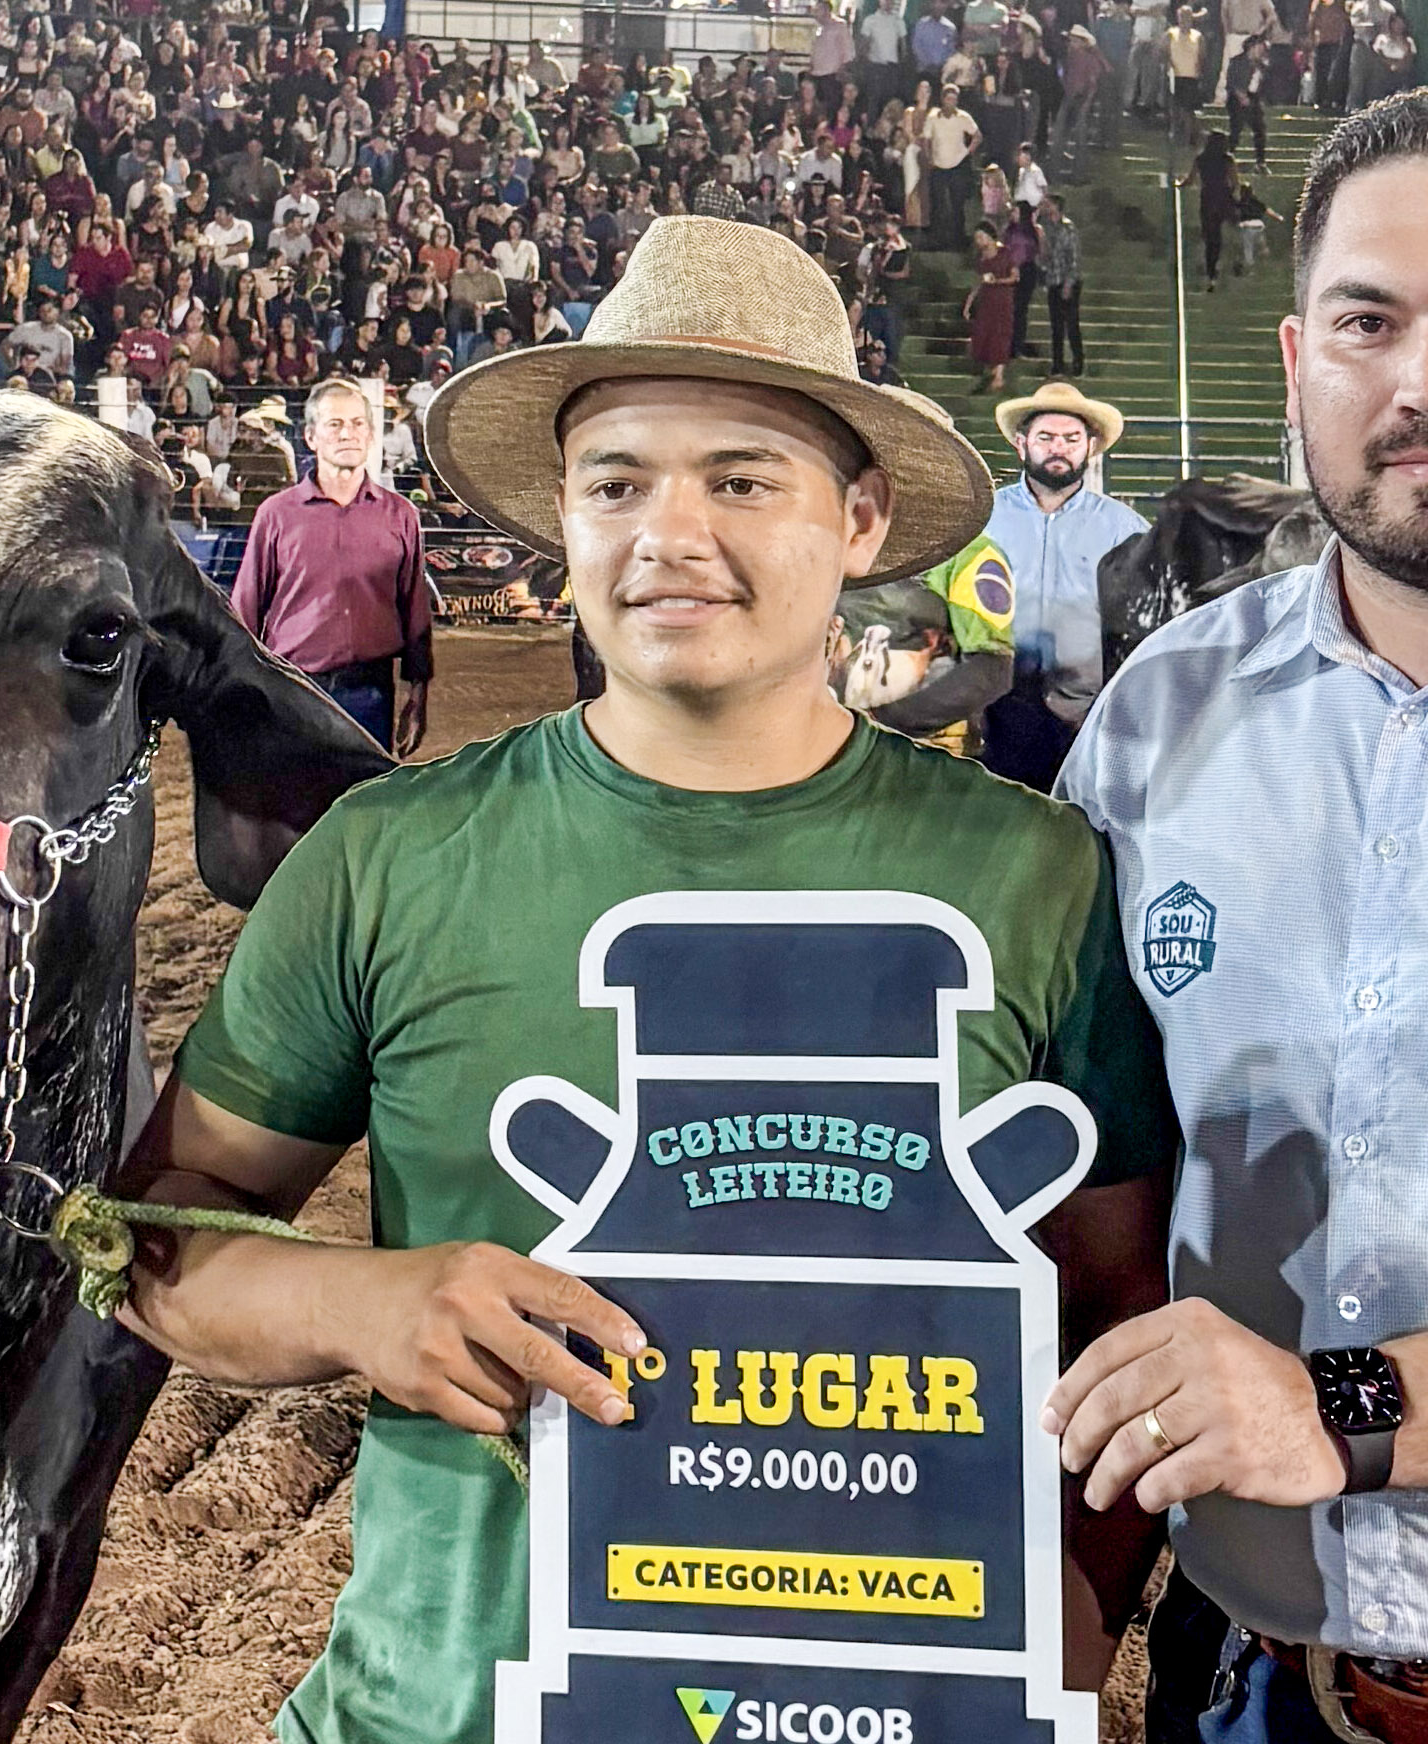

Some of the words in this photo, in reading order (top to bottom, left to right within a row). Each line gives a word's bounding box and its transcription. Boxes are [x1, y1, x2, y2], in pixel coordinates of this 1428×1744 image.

[1159, 914, 1193, 934] SOU
[1149, 942, 1203, 966] RURAL
[647, 1112, 931, 1171] CONCURSO
[682, 1162, 894, 1211] LEITEIRO
[690, 1348, 985, 1434] LUGAR
[668, 1441, 918, 1501] R$9.000,00
[634, 1559, 850, 1597] CATEGORIA:
[858, 1569, 956, 1601] VACA
